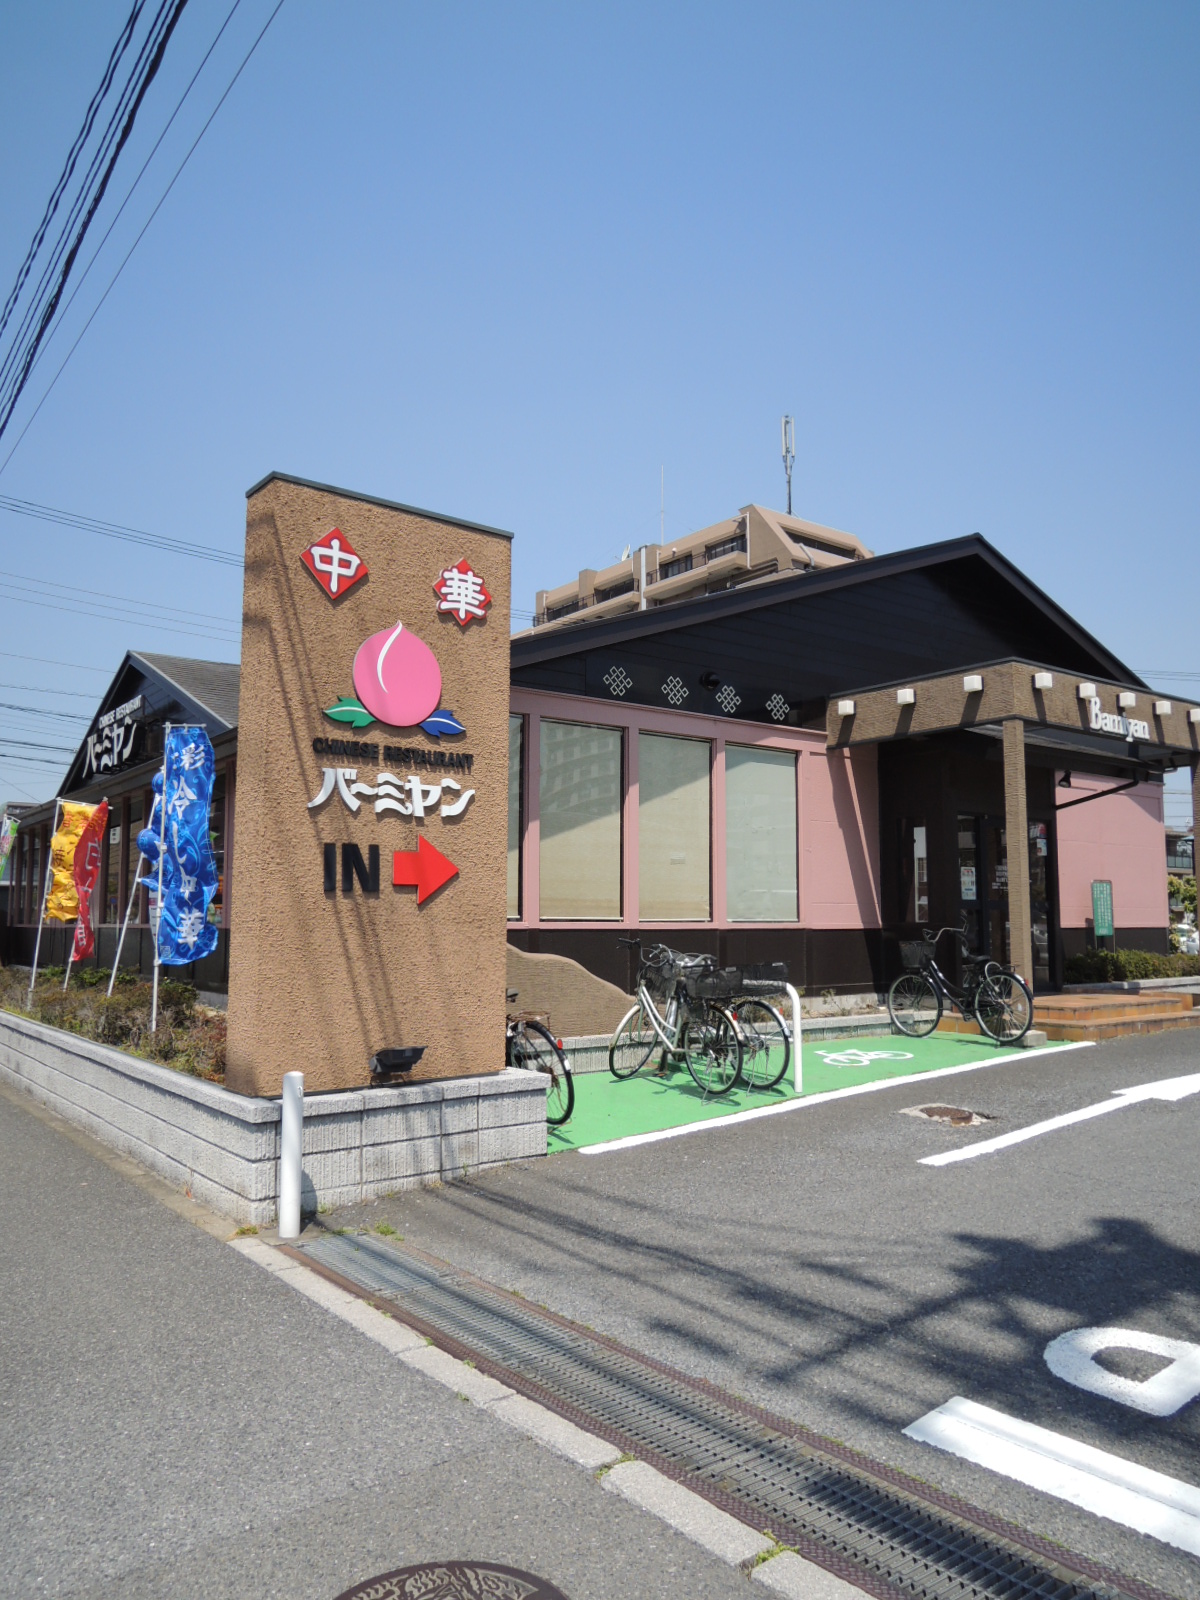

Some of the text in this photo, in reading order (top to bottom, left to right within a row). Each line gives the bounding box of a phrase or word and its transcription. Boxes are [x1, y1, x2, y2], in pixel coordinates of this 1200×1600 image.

[1089, 697, 1150, 742] Bamiyan
[82, 715, 137, 779] バーミヤン
[313, 737, 474, 768] CHINESE RESTAURANT
[307, 767, 476, 817] バーミヤン
[323, 842, 380, 892] IN
